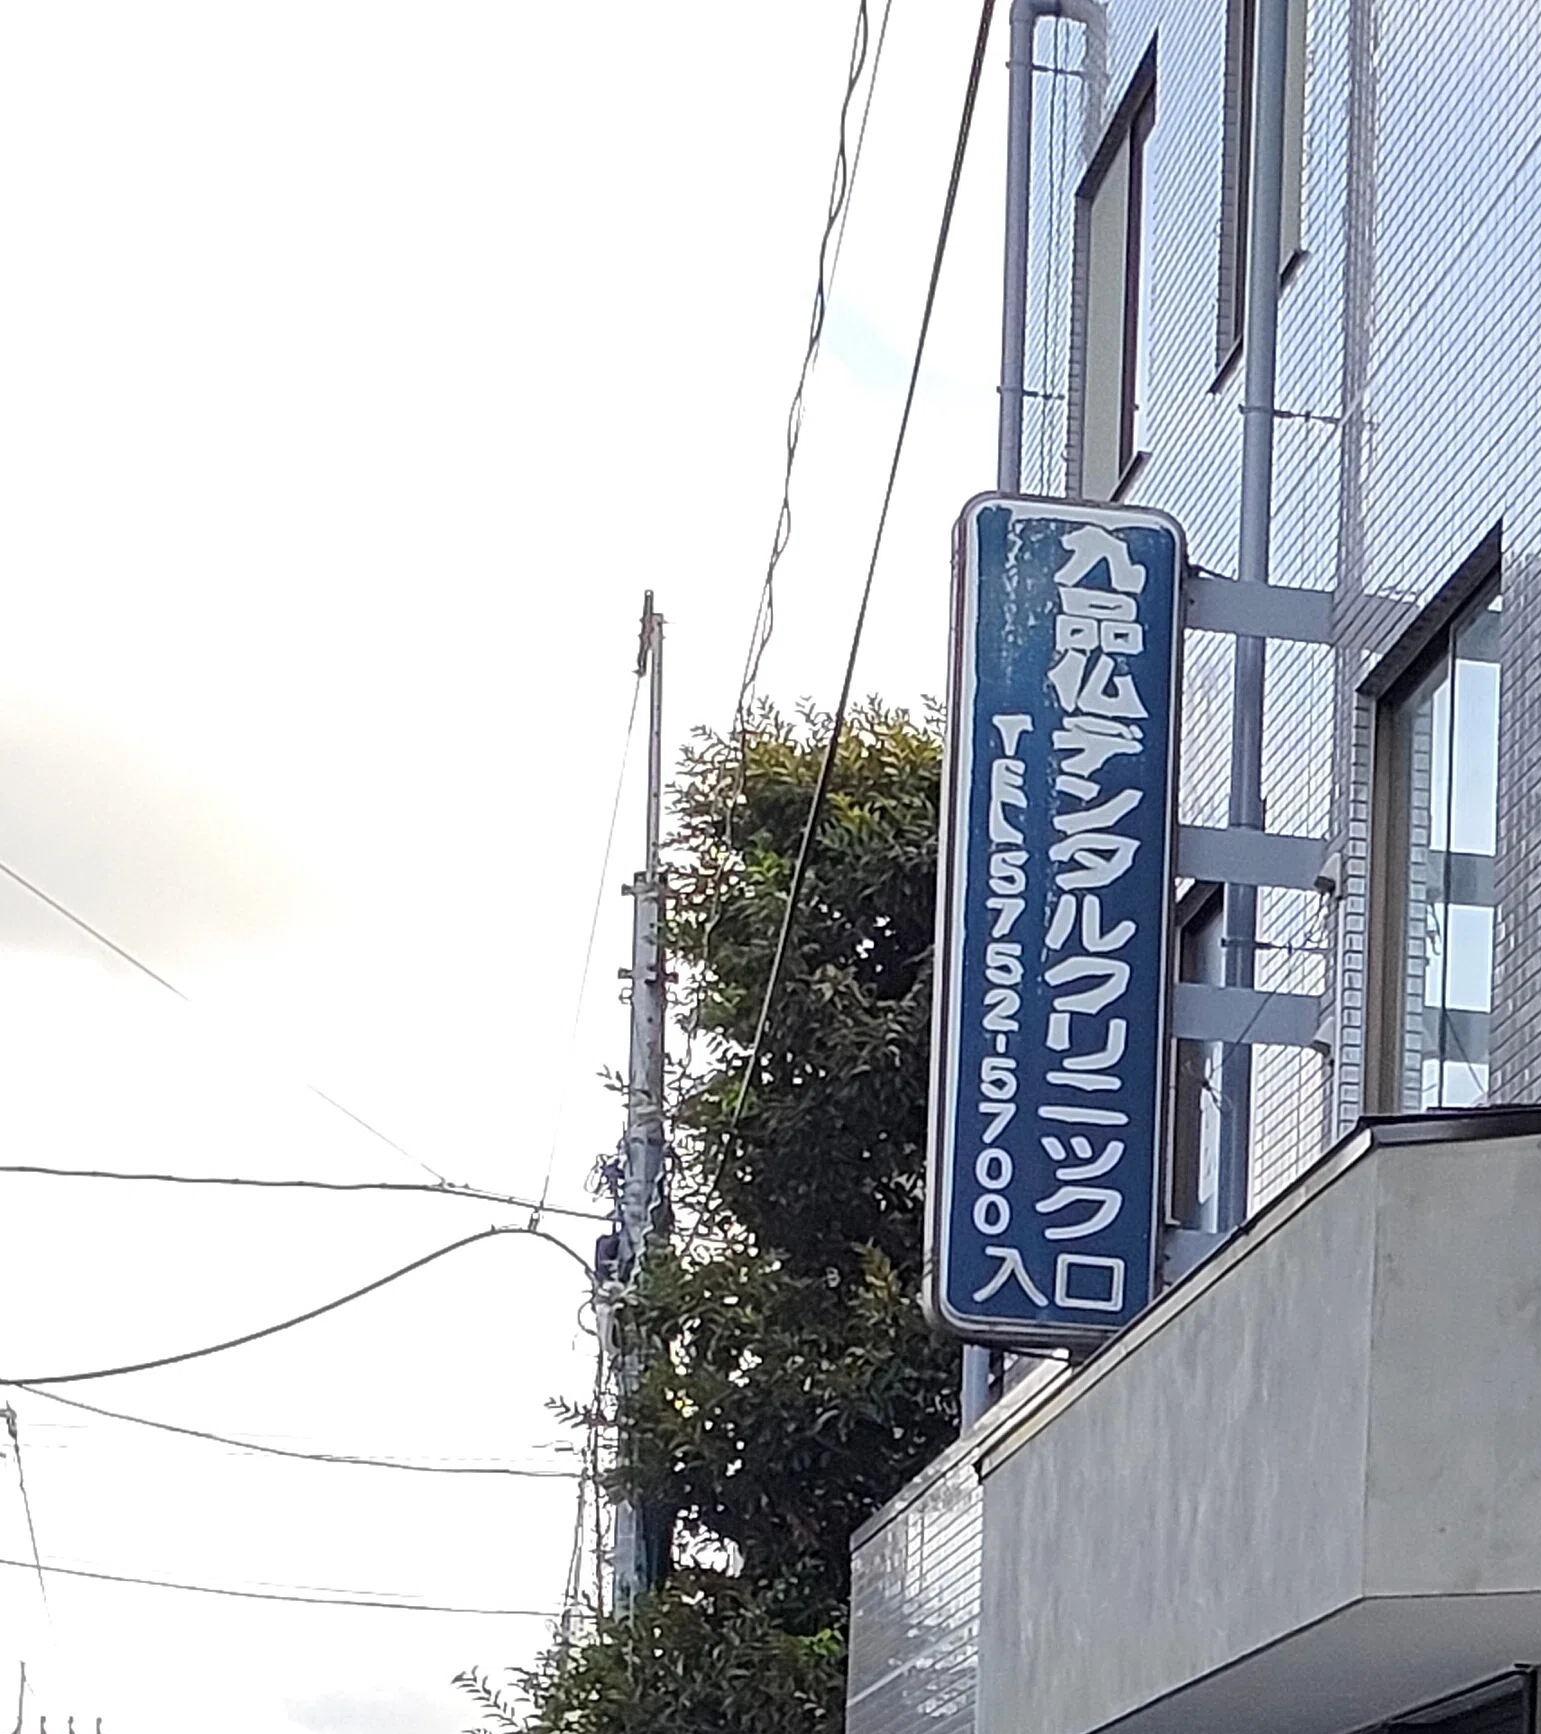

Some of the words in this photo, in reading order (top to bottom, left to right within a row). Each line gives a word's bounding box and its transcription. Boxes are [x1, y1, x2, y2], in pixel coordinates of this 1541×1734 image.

[1034, 523, 1149, 1241] 九品仏デンタルクリニック
[972, 1246, 1126, 1312] 入口
